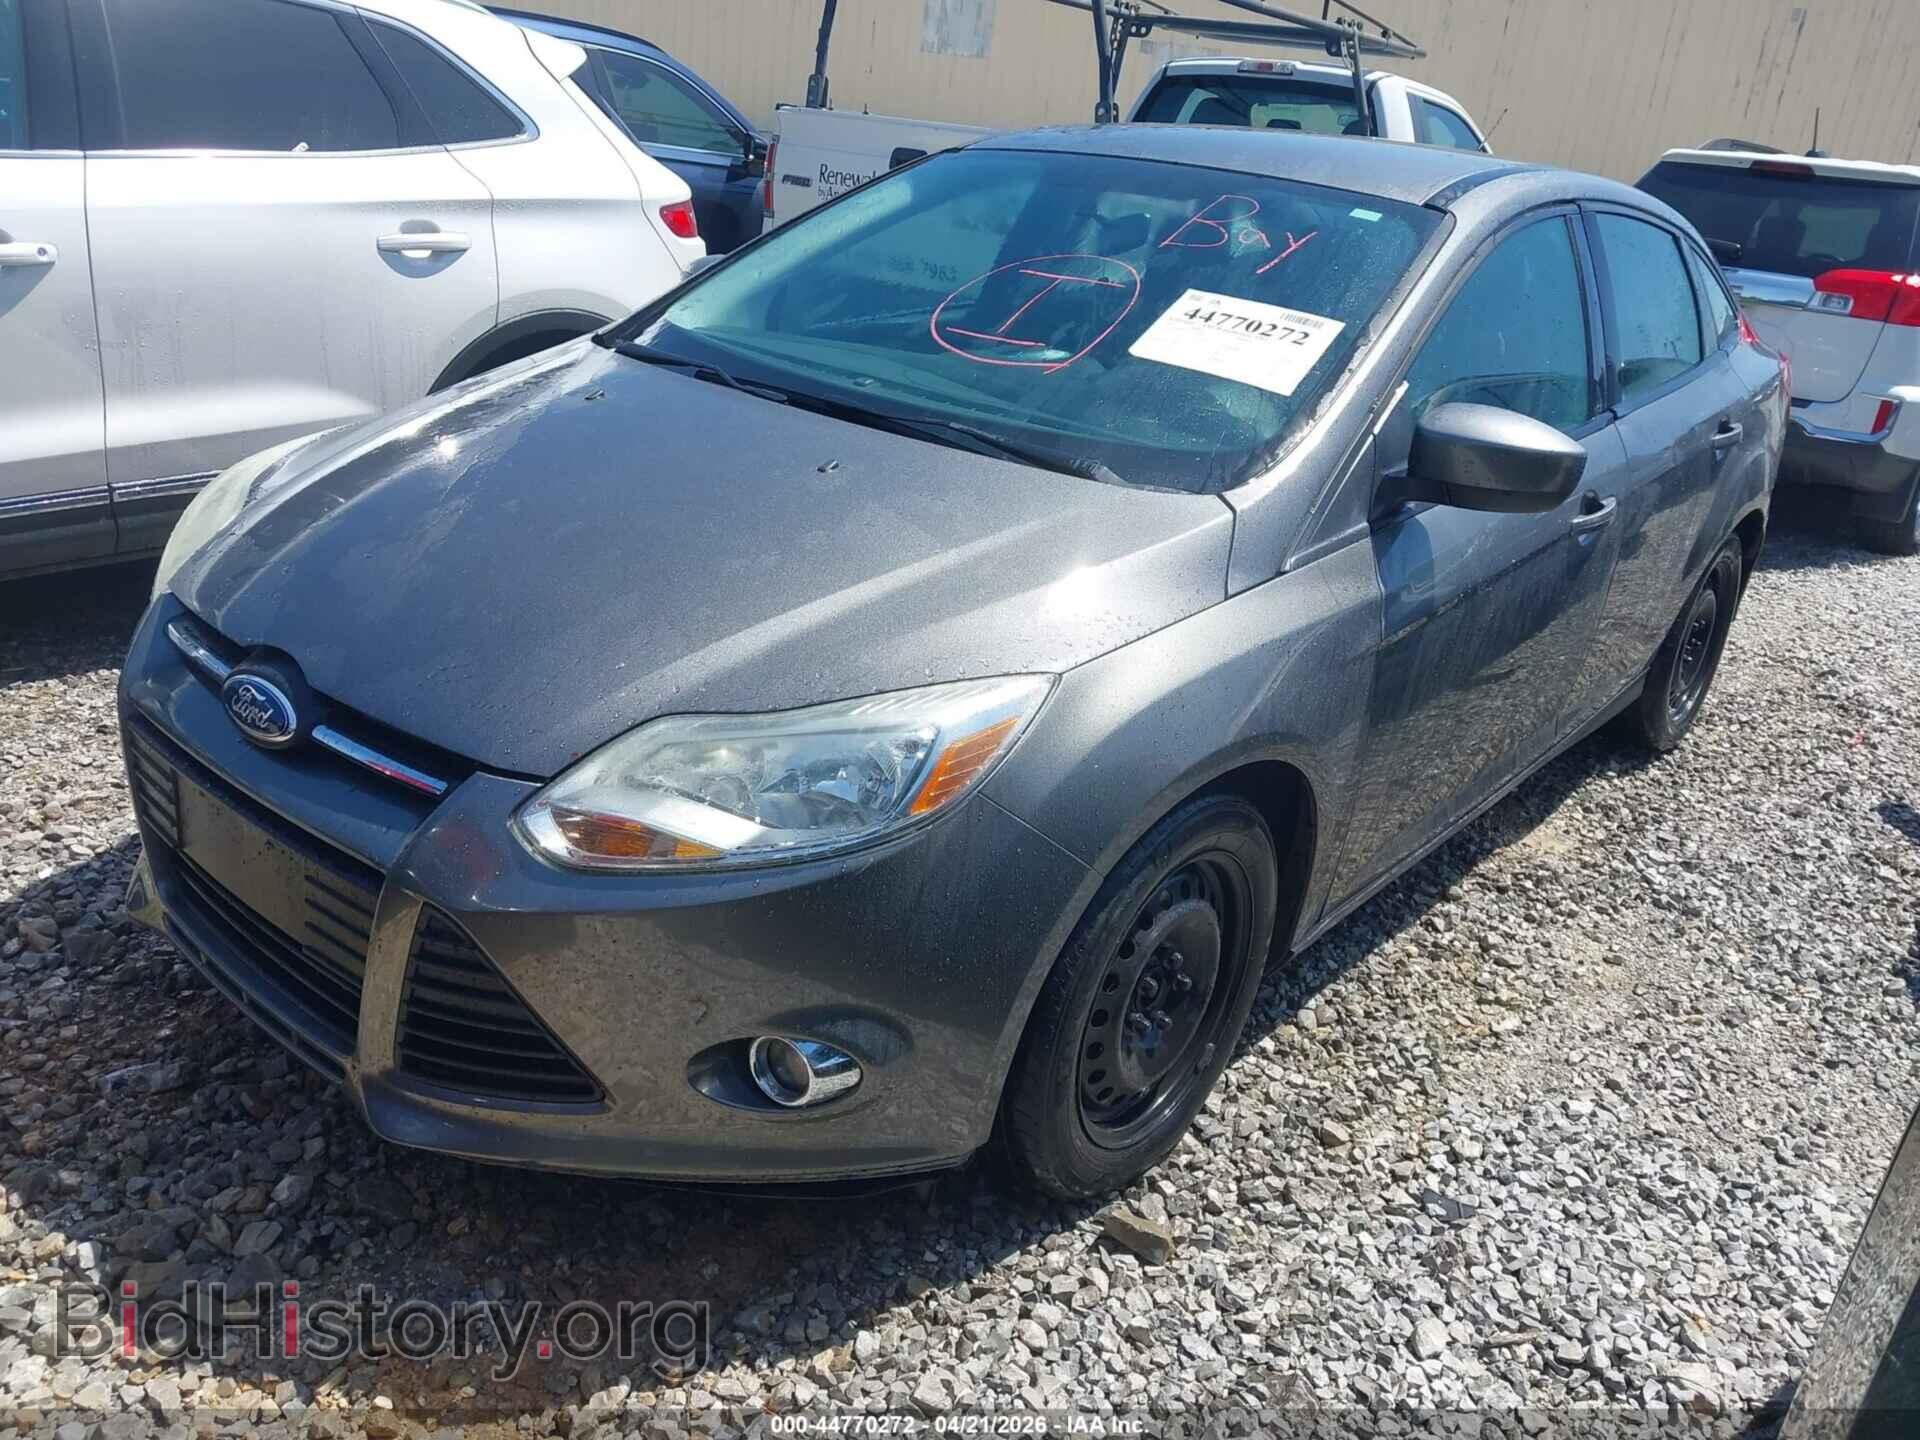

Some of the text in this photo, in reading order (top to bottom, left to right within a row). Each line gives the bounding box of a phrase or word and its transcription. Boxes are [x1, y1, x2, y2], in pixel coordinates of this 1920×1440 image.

[1158, 194, 1318, 274] Bay
[1183, 306, 1311, 346] 44770272
[231, 684, 274, 729] Ford
